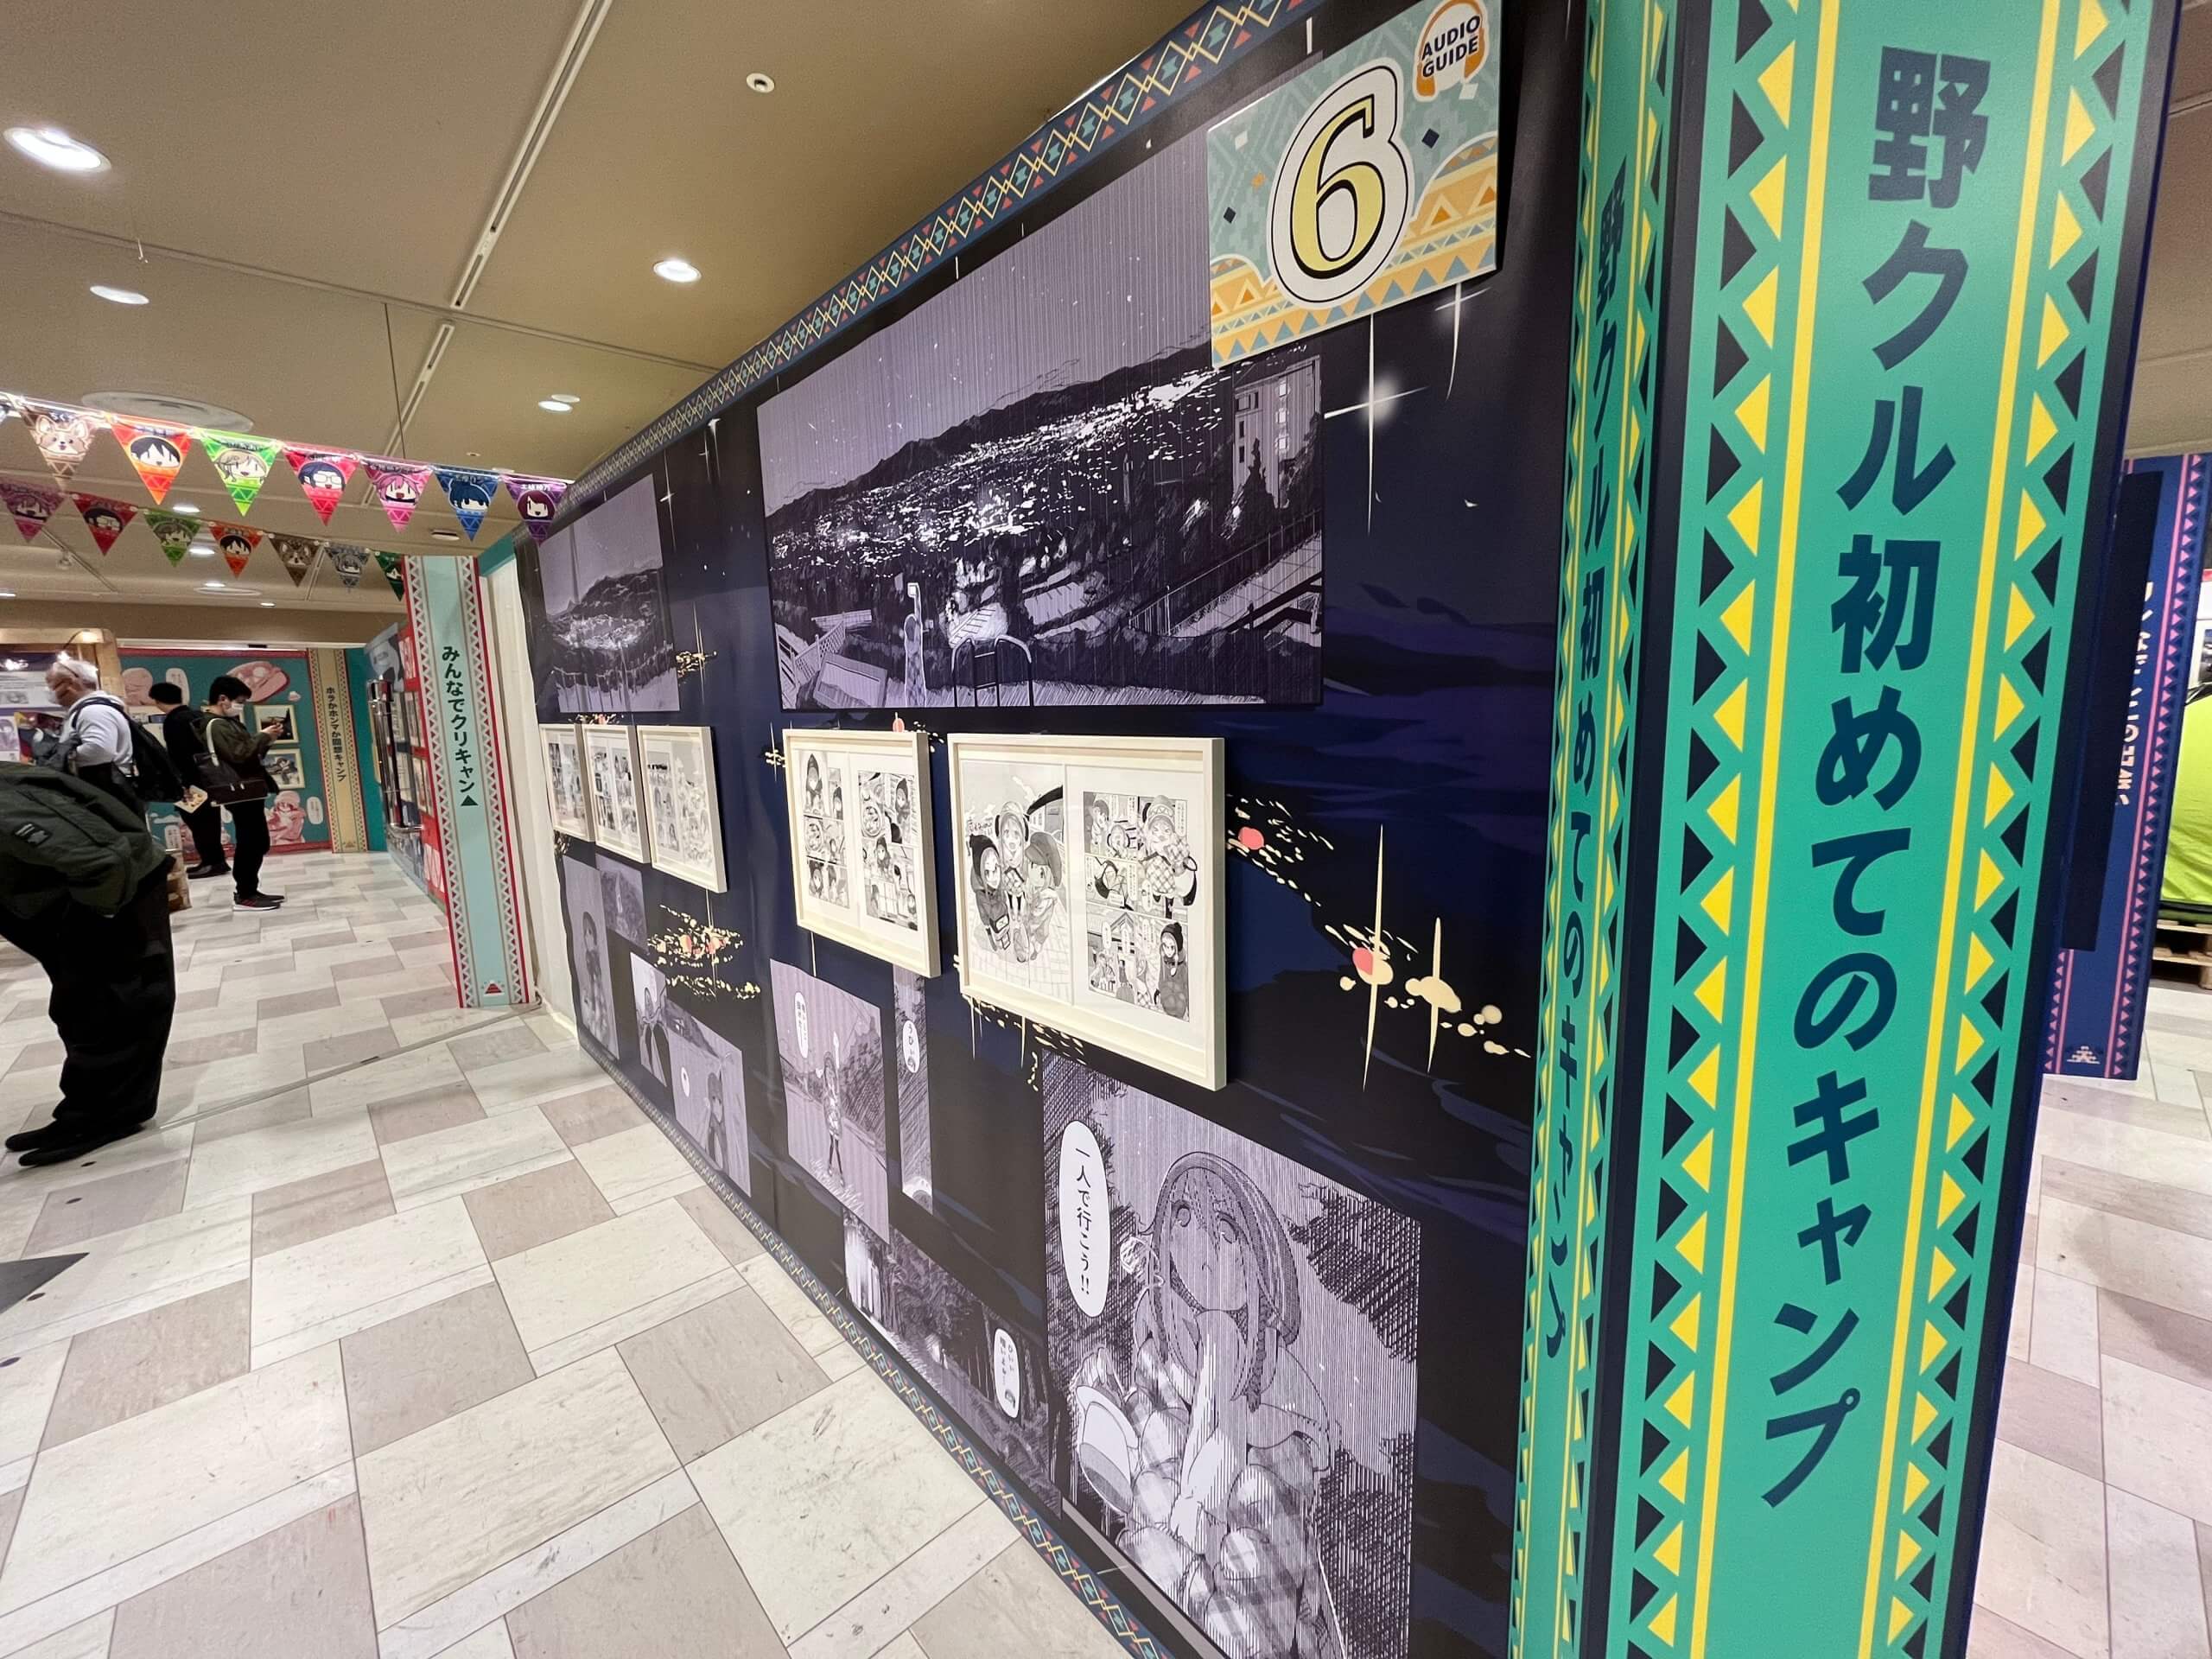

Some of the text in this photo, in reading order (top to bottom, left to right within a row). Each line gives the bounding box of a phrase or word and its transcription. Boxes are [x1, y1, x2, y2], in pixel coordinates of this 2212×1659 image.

[1421, 15, 1481, 61] AUDIO
[1422, 35, 1478, 78] GUIDE
[1290, 93, 1386, 280] 6
[1763, 45, 1991, 1508] 野クル初めてのキャンプ
